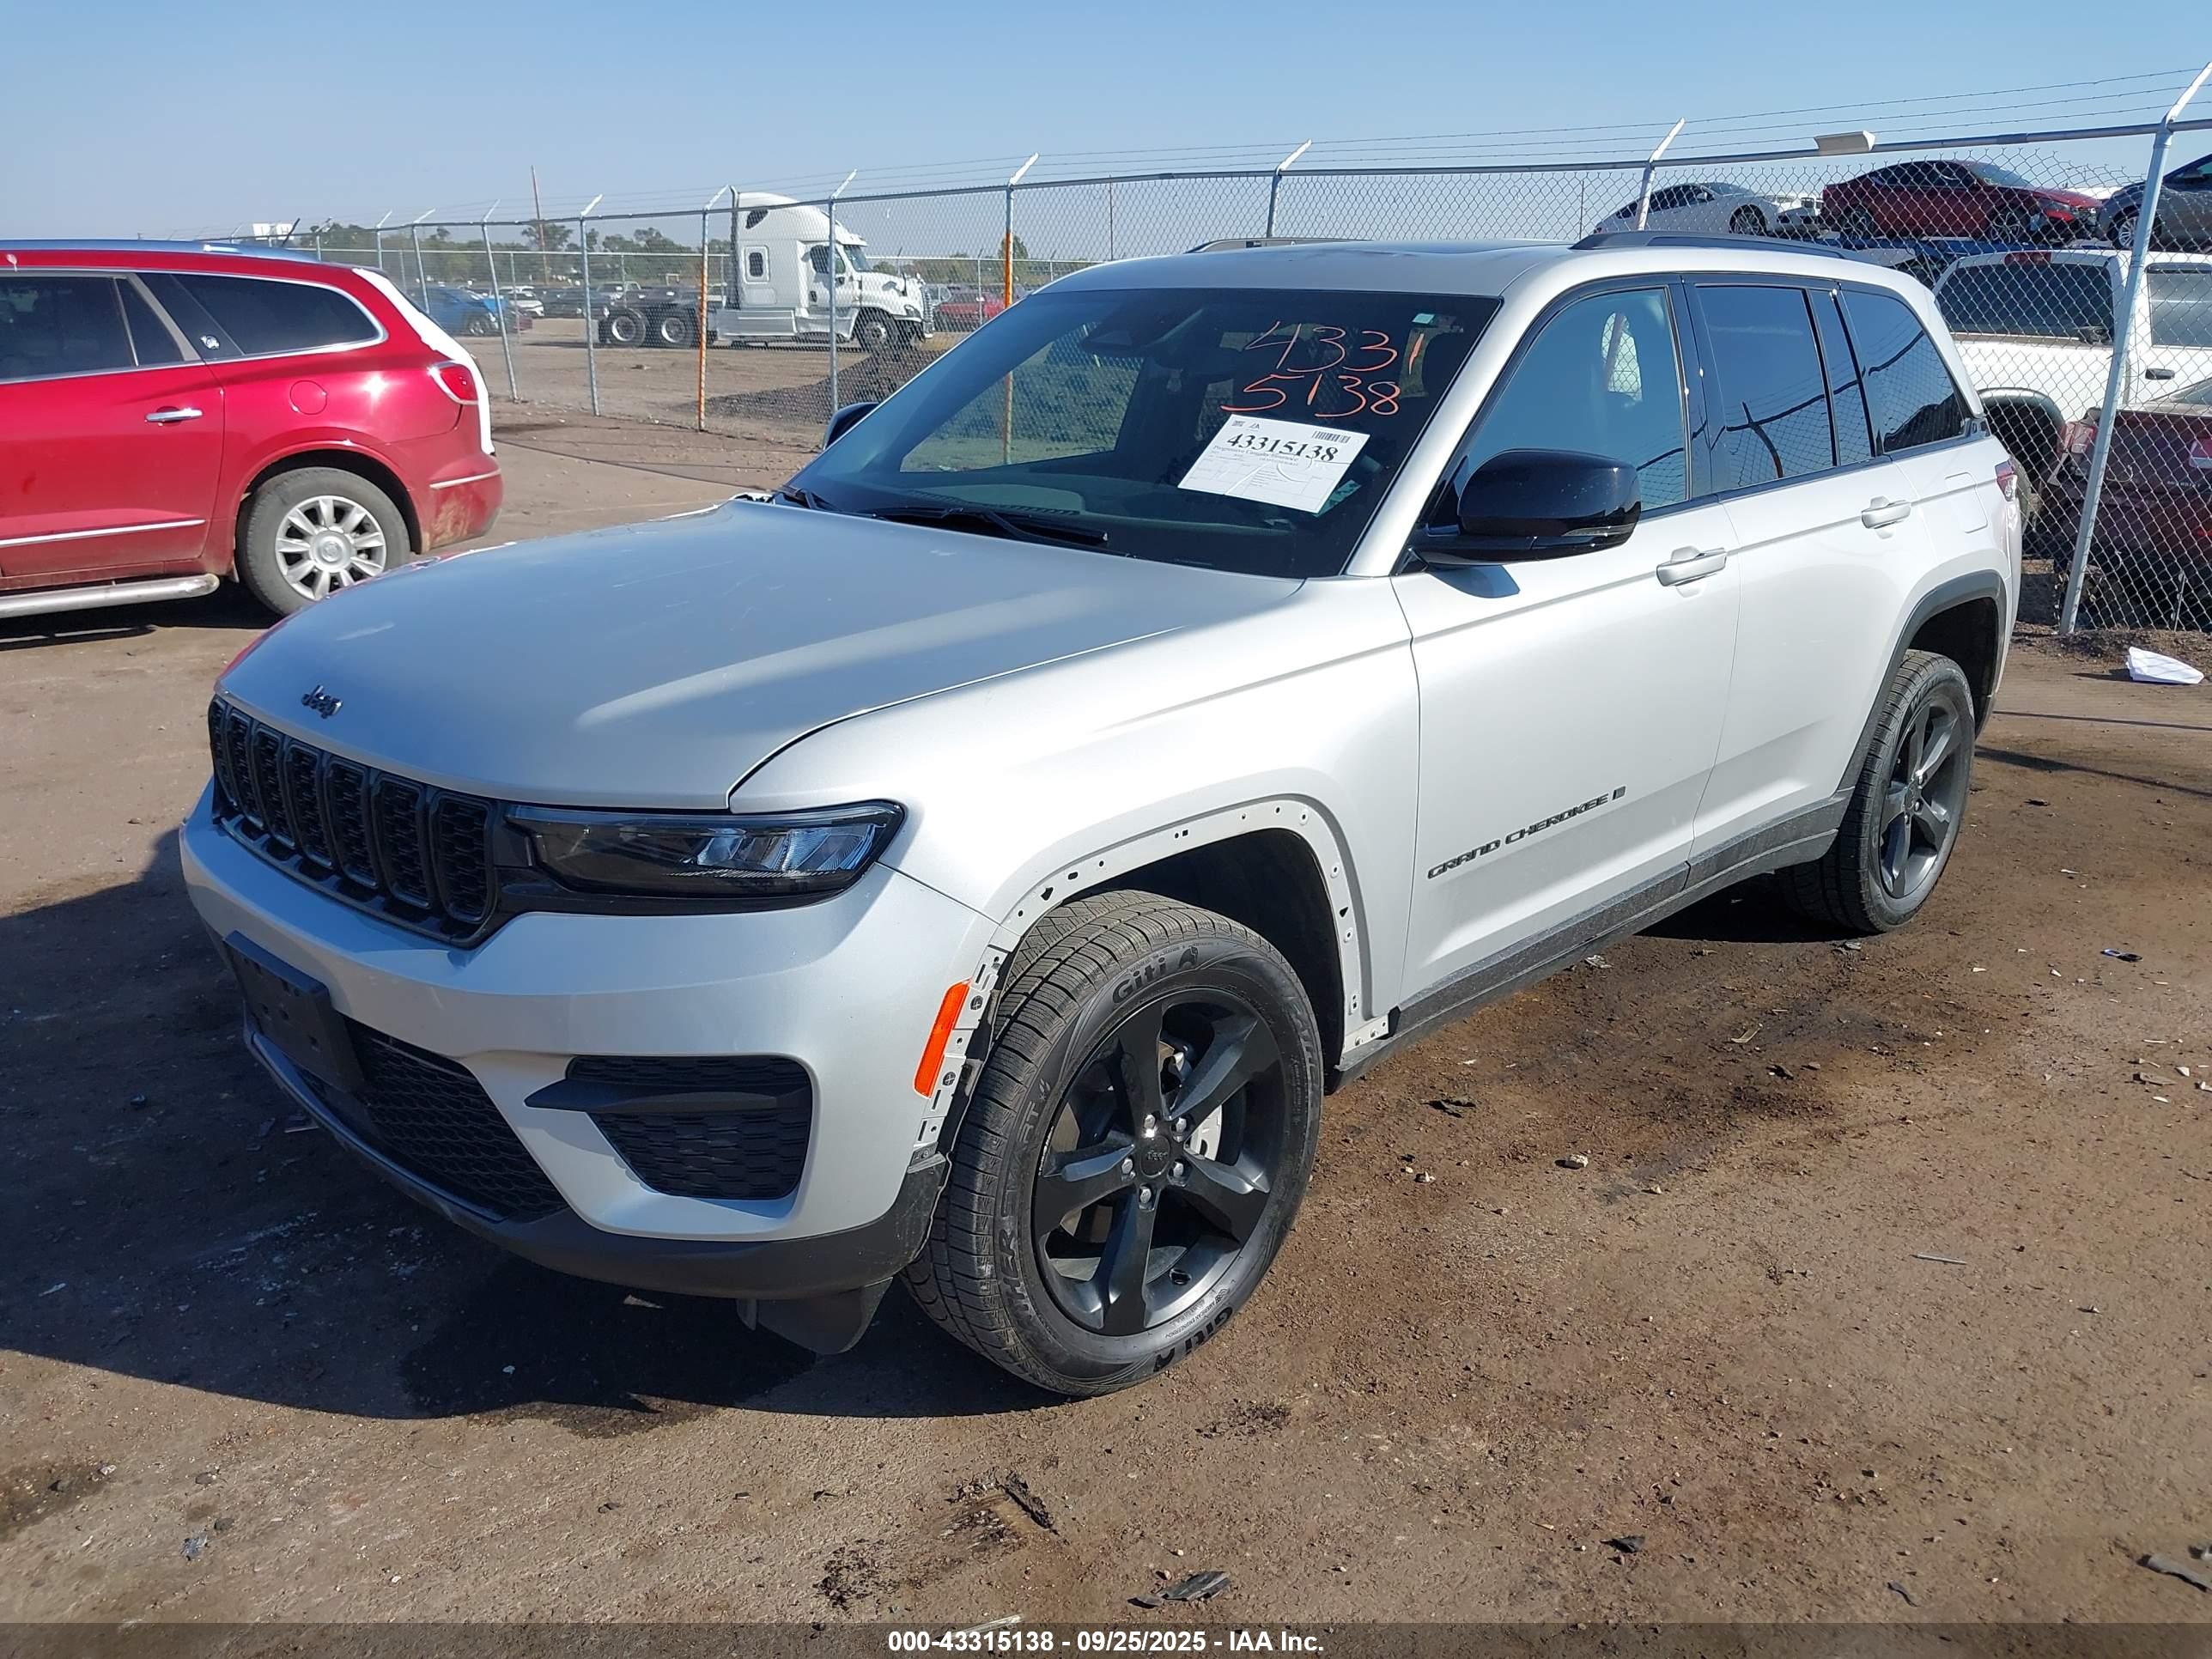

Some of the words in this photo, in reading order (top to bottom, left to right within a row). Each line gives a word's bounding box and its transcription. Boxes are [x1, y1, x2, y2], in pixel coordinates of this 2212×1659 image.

[1245, 320, 1425, 374] 4331
[1219, 373, 1401, 418] 5138
[1226, 433, 1339, 462] 43315138
[1426, 839, 1502, 879] GRAND
[1504, 793, 1609, 845] CHEROKEE
[1112, 956, 1167, 1004] Giti
